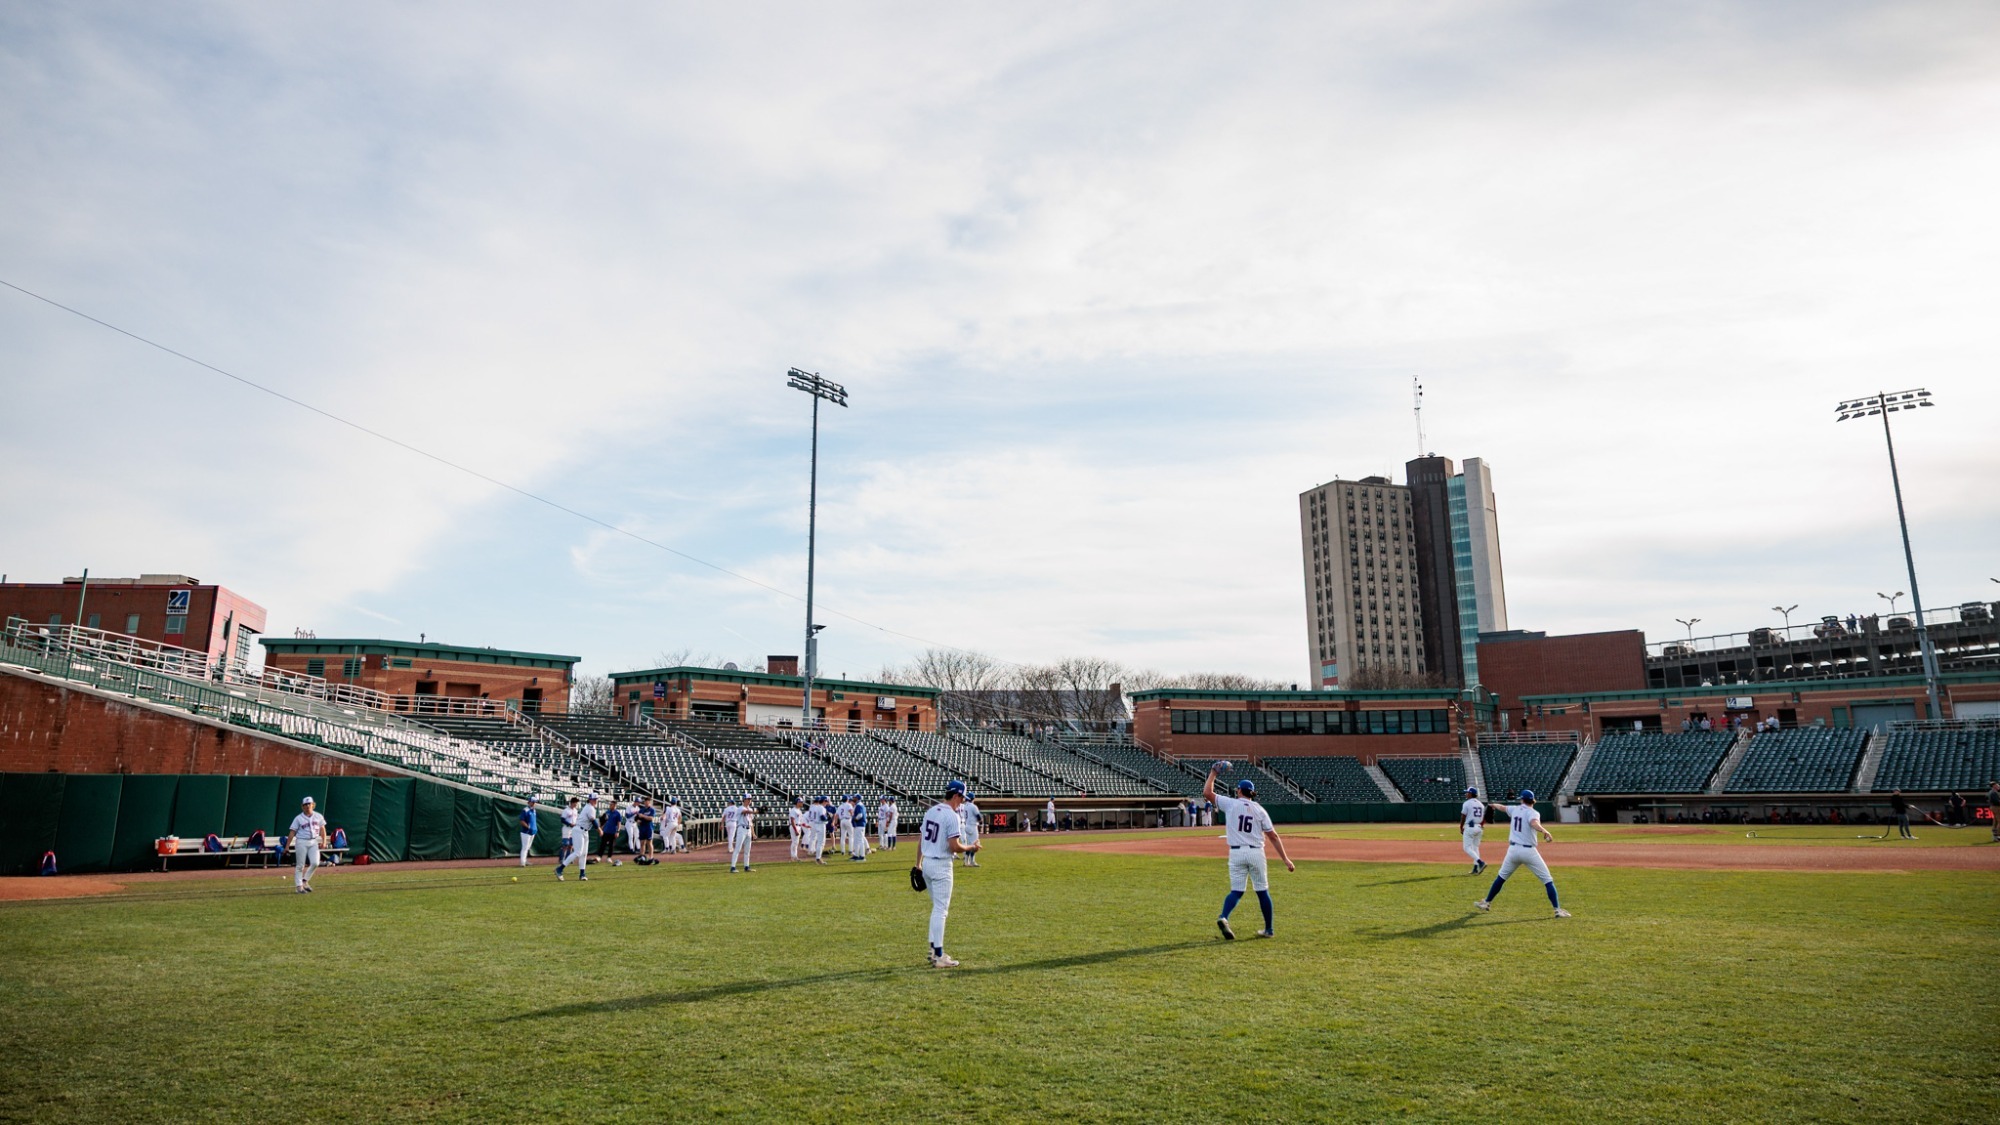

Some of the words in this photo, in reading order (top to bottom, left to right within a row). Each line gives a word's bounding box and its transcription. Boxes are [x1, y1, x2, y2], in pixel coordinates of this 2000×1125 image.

[1473, 806, 1482, 817] 23
[924, 820, 940, 843] 50
[1238, 814, 1253, 833] 16
[1514, 816, 1522, 832] 11
